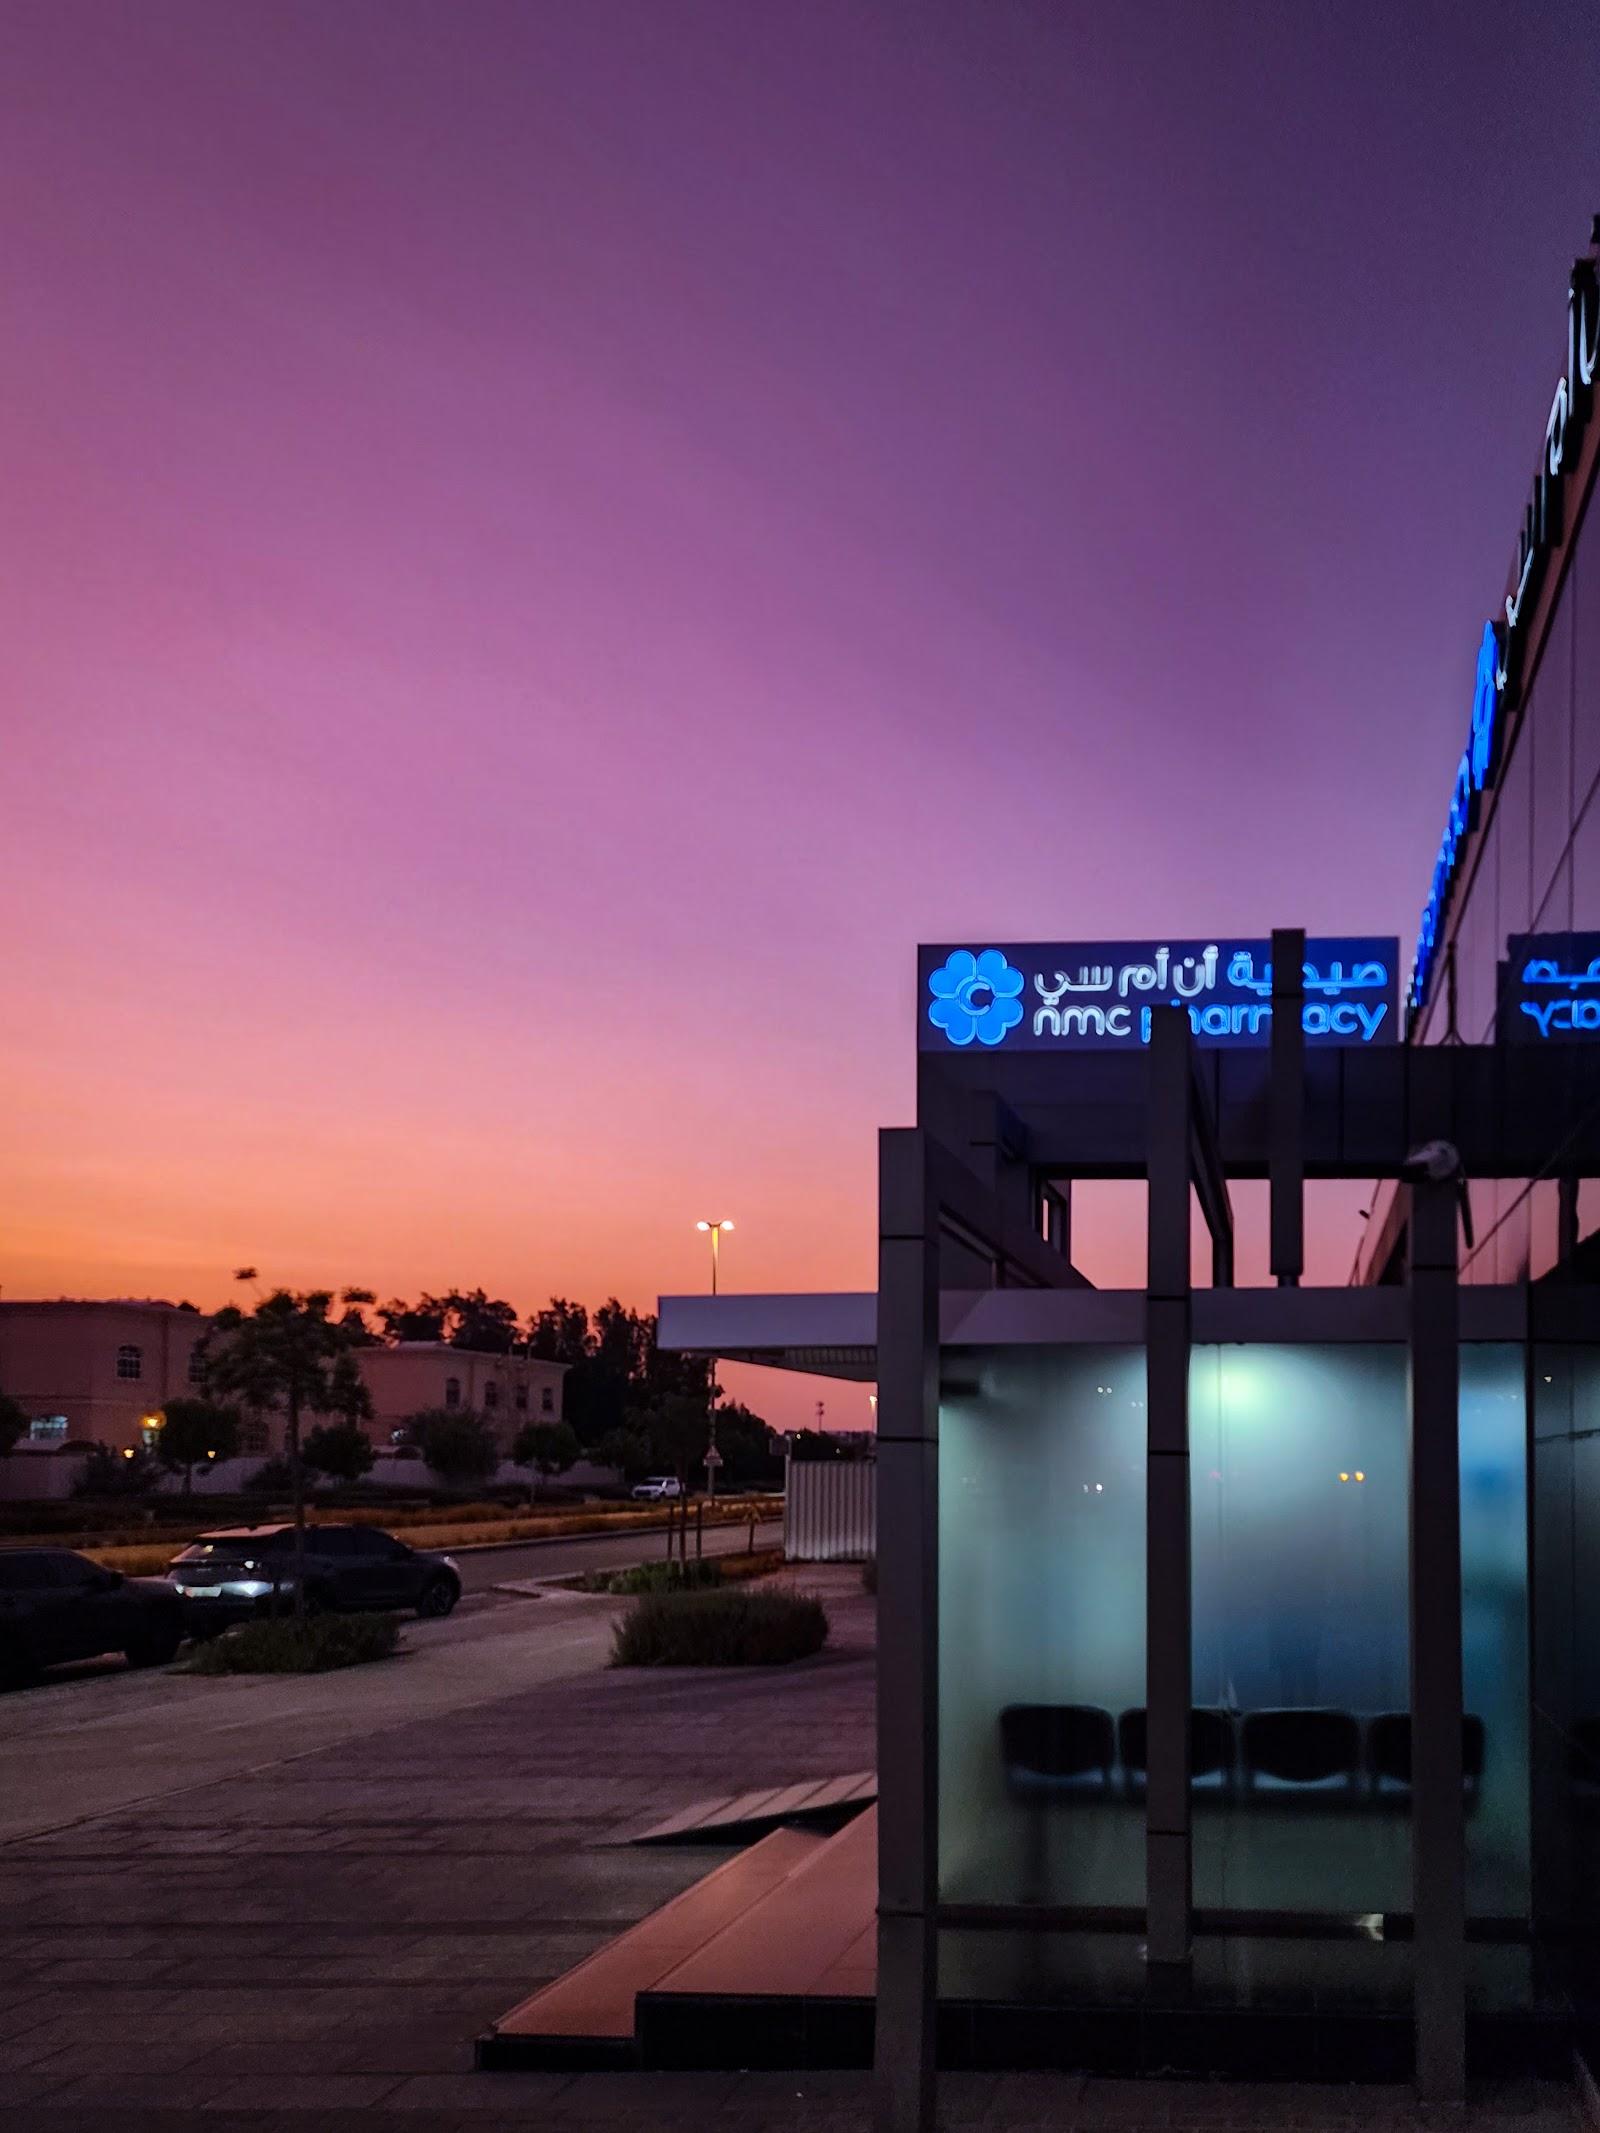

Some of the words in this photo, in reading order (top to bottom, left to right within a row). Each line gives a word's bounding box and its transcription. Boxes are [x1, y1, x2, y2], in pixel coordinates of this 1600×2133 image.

[1034, 964, 1114, 1006] سي
[1227, 951, 1388, 997] صيدية
[1033, 1004, 1132, 1037] nmc
